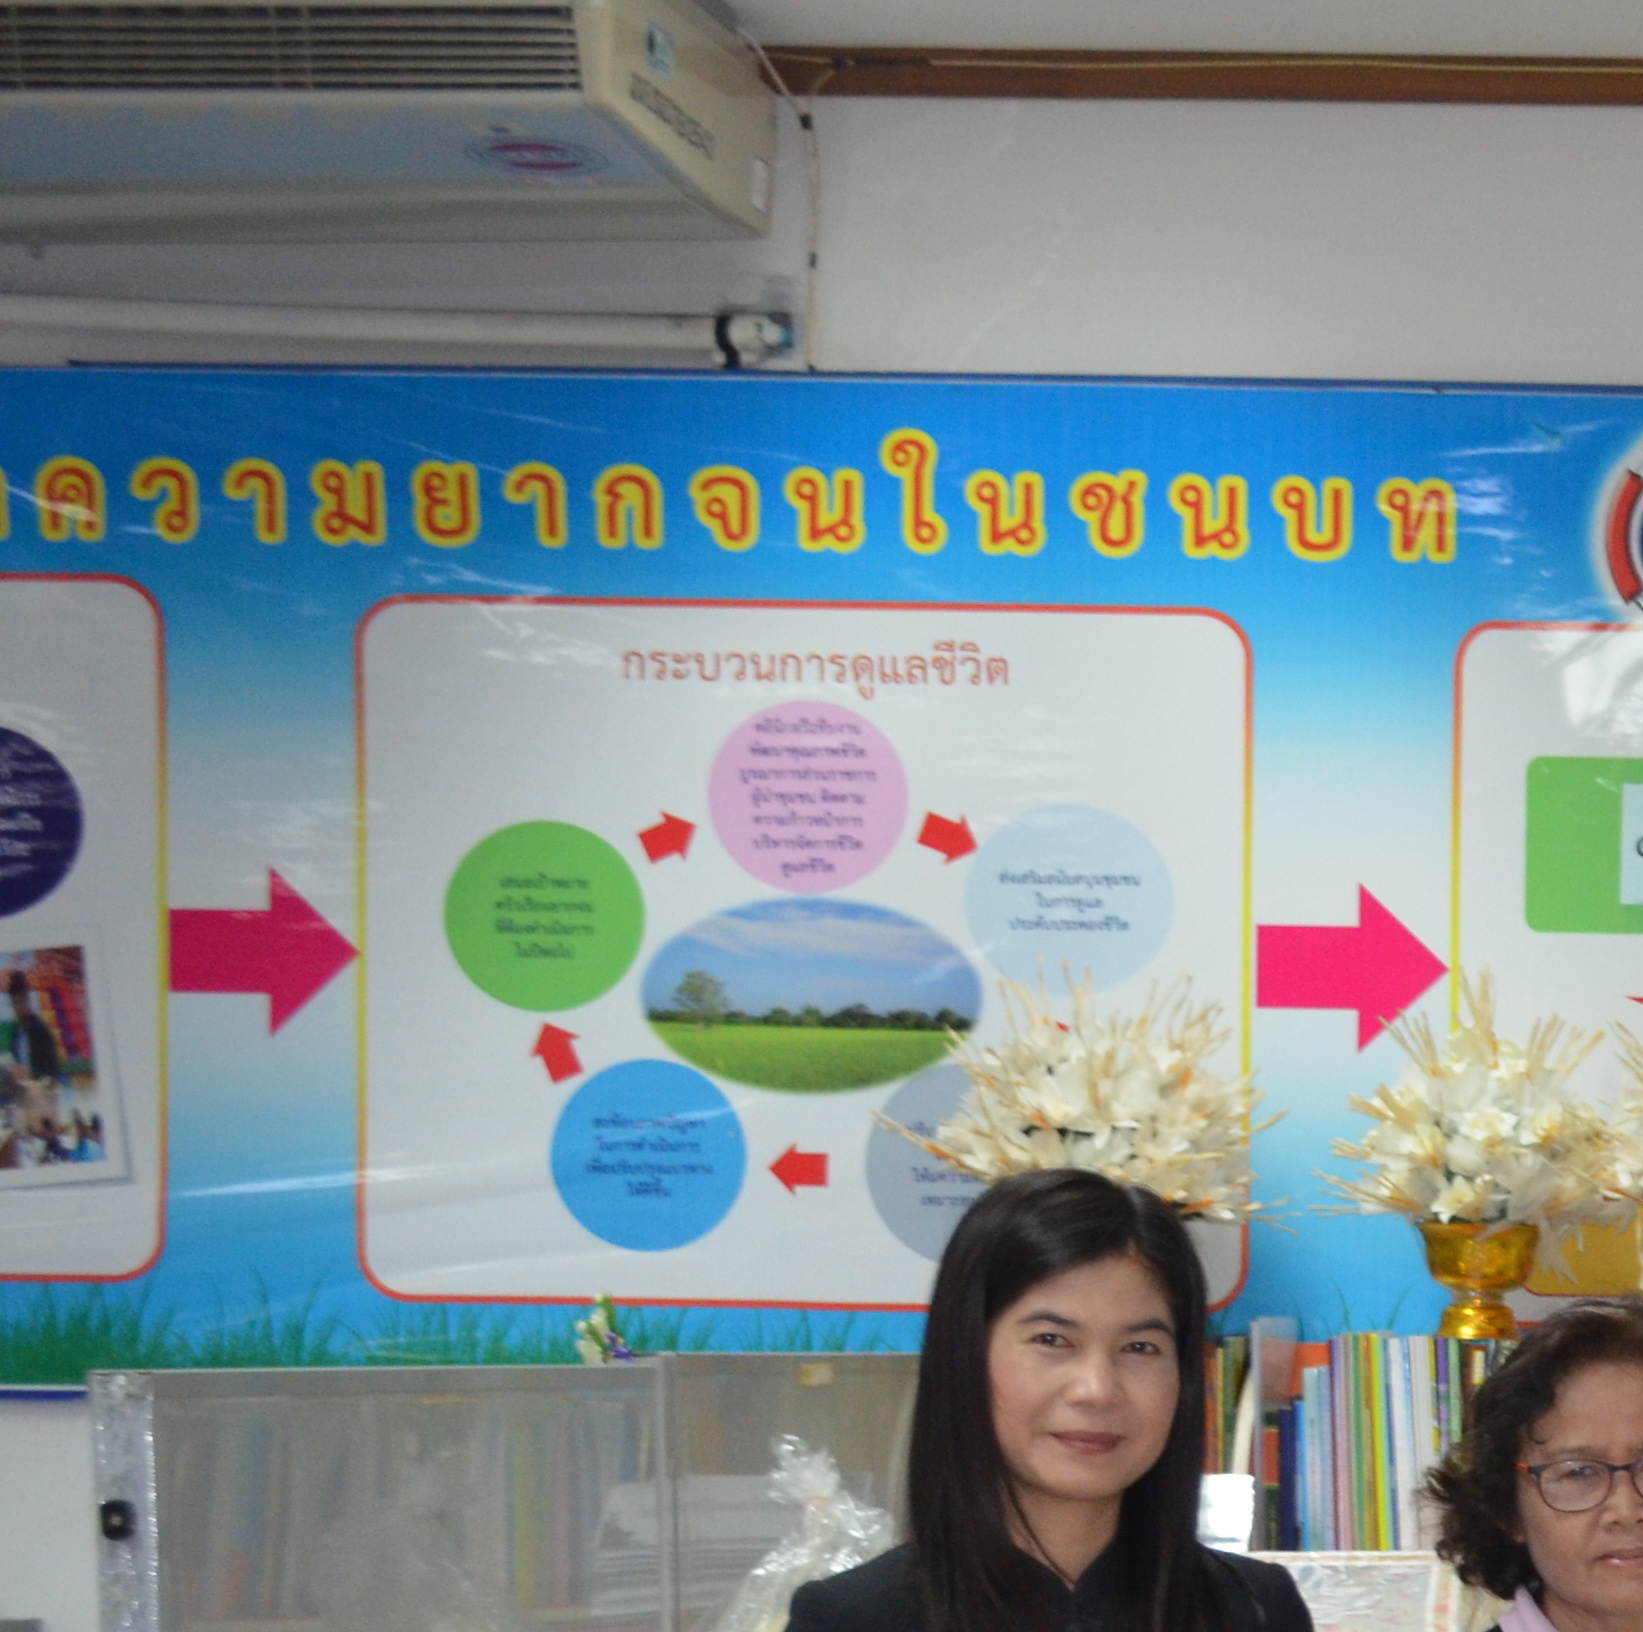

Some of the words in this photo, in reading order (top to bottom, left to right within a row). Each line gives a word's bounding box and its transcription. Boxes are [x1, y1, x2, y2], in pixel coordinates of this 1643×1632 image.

[0, 430, 1457, 563] ความยากจนในชนบท
[622, 640, 1010, 699] กระบวนการดูแลชีวิต
